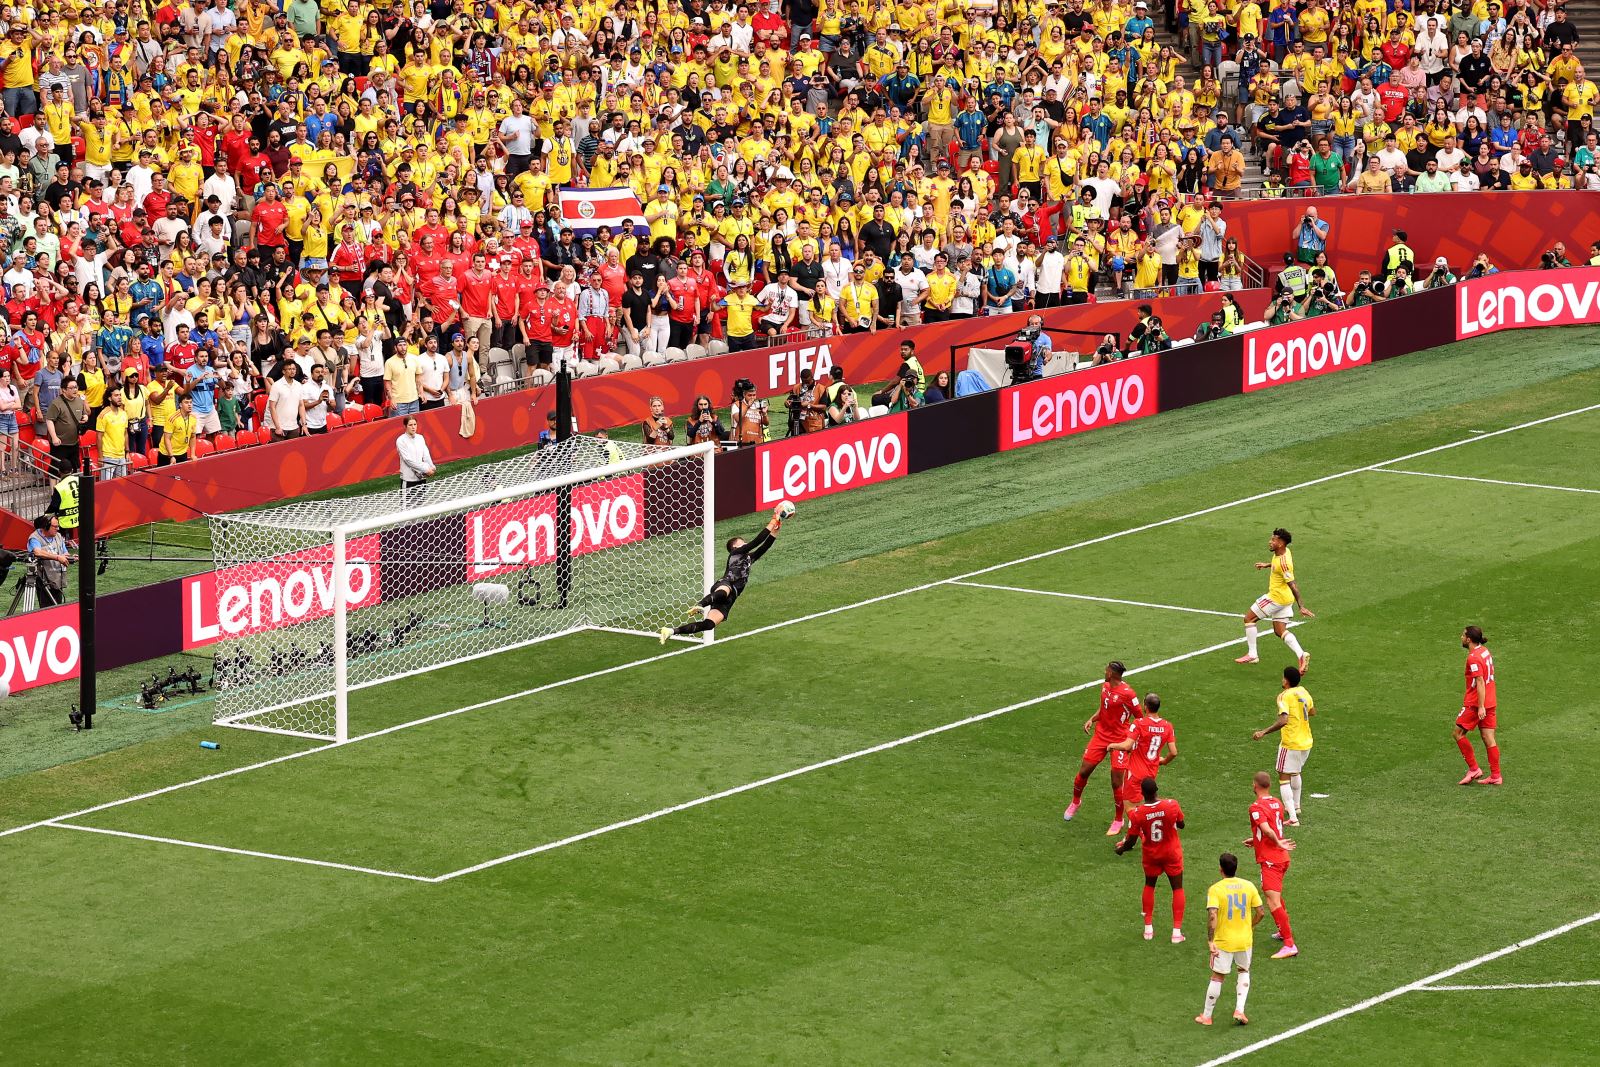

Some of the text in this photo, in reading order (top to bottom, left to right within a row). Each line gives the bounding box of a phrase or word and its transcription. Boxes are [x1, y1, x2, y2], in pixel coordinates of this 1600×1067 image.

[1461, 281, 1600, 334] Lenov
[769, 344, 833, 389] FIFA
[1248, 323, 1367, 386] Lenovo
[1011, 374, 1145, 443] Lenovo
[762, 432, 901, 503] Lenovo
[191, 556, 372, 642] Lenovo
[1146, 735, 1162, 760] 8
[1150, 819, 1163, 841] 6
[1227, 893, 1246, 920] 14
